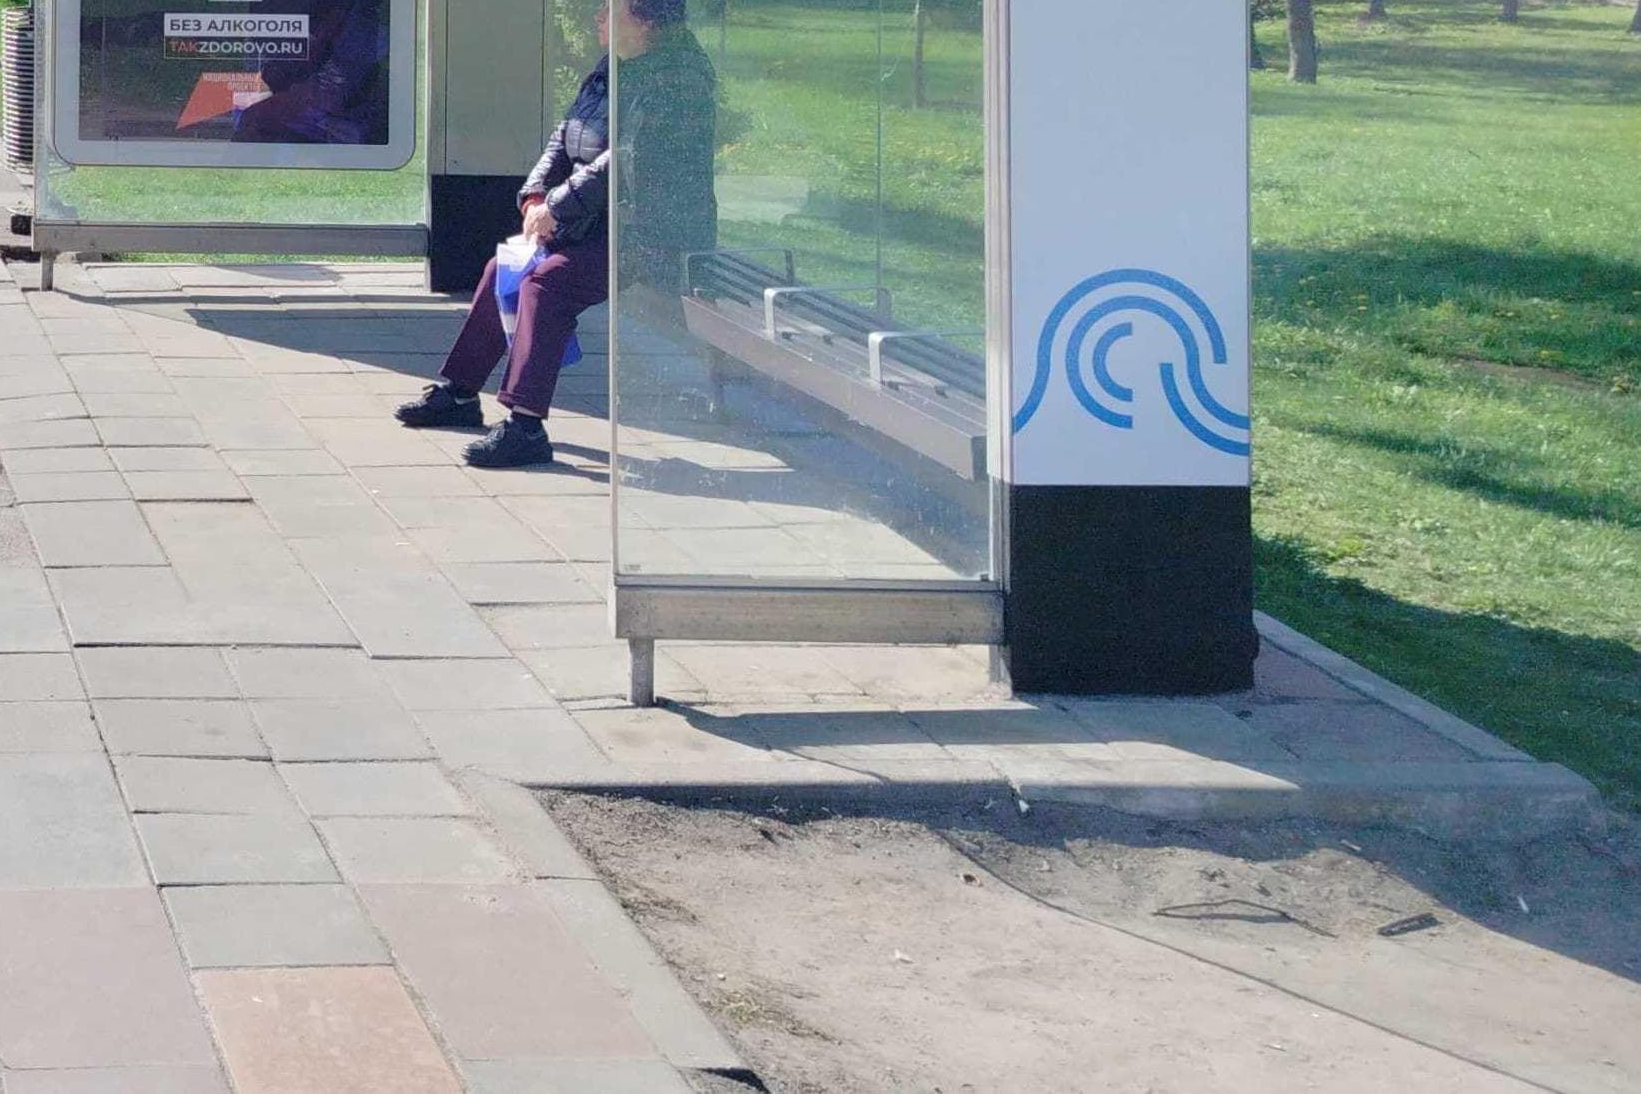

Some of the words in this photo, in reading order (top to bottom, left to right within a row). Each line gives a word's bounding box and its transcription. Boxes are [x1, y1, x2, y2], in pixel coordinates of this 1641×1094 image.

[169, 18, 202, 32] БЕЗ
[206, 19, 303, 33] АЛКОГОЛЯ
[167, 40, 304, 55] TAKZDOROVO.RU
